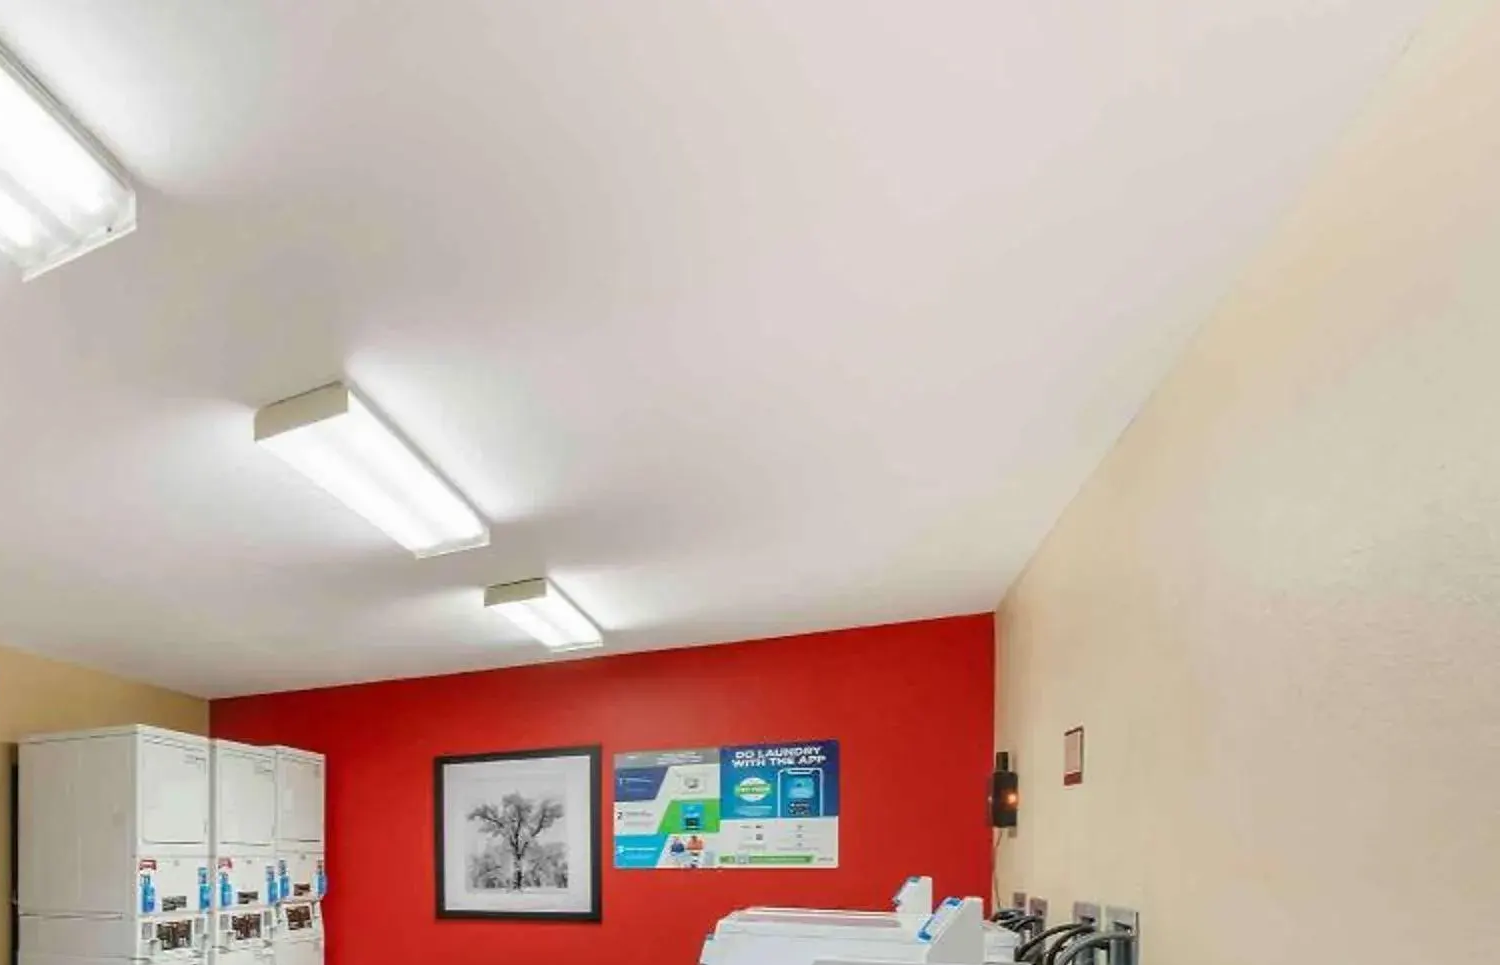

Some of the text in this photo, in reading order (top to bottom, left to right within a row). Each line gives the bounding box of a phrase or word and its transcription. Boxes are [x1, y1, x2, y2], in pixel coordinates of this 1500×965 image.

[735, 747, 821, 760] DO LAUNDRY
[732, 755, 827, 768] WITH THE APP
